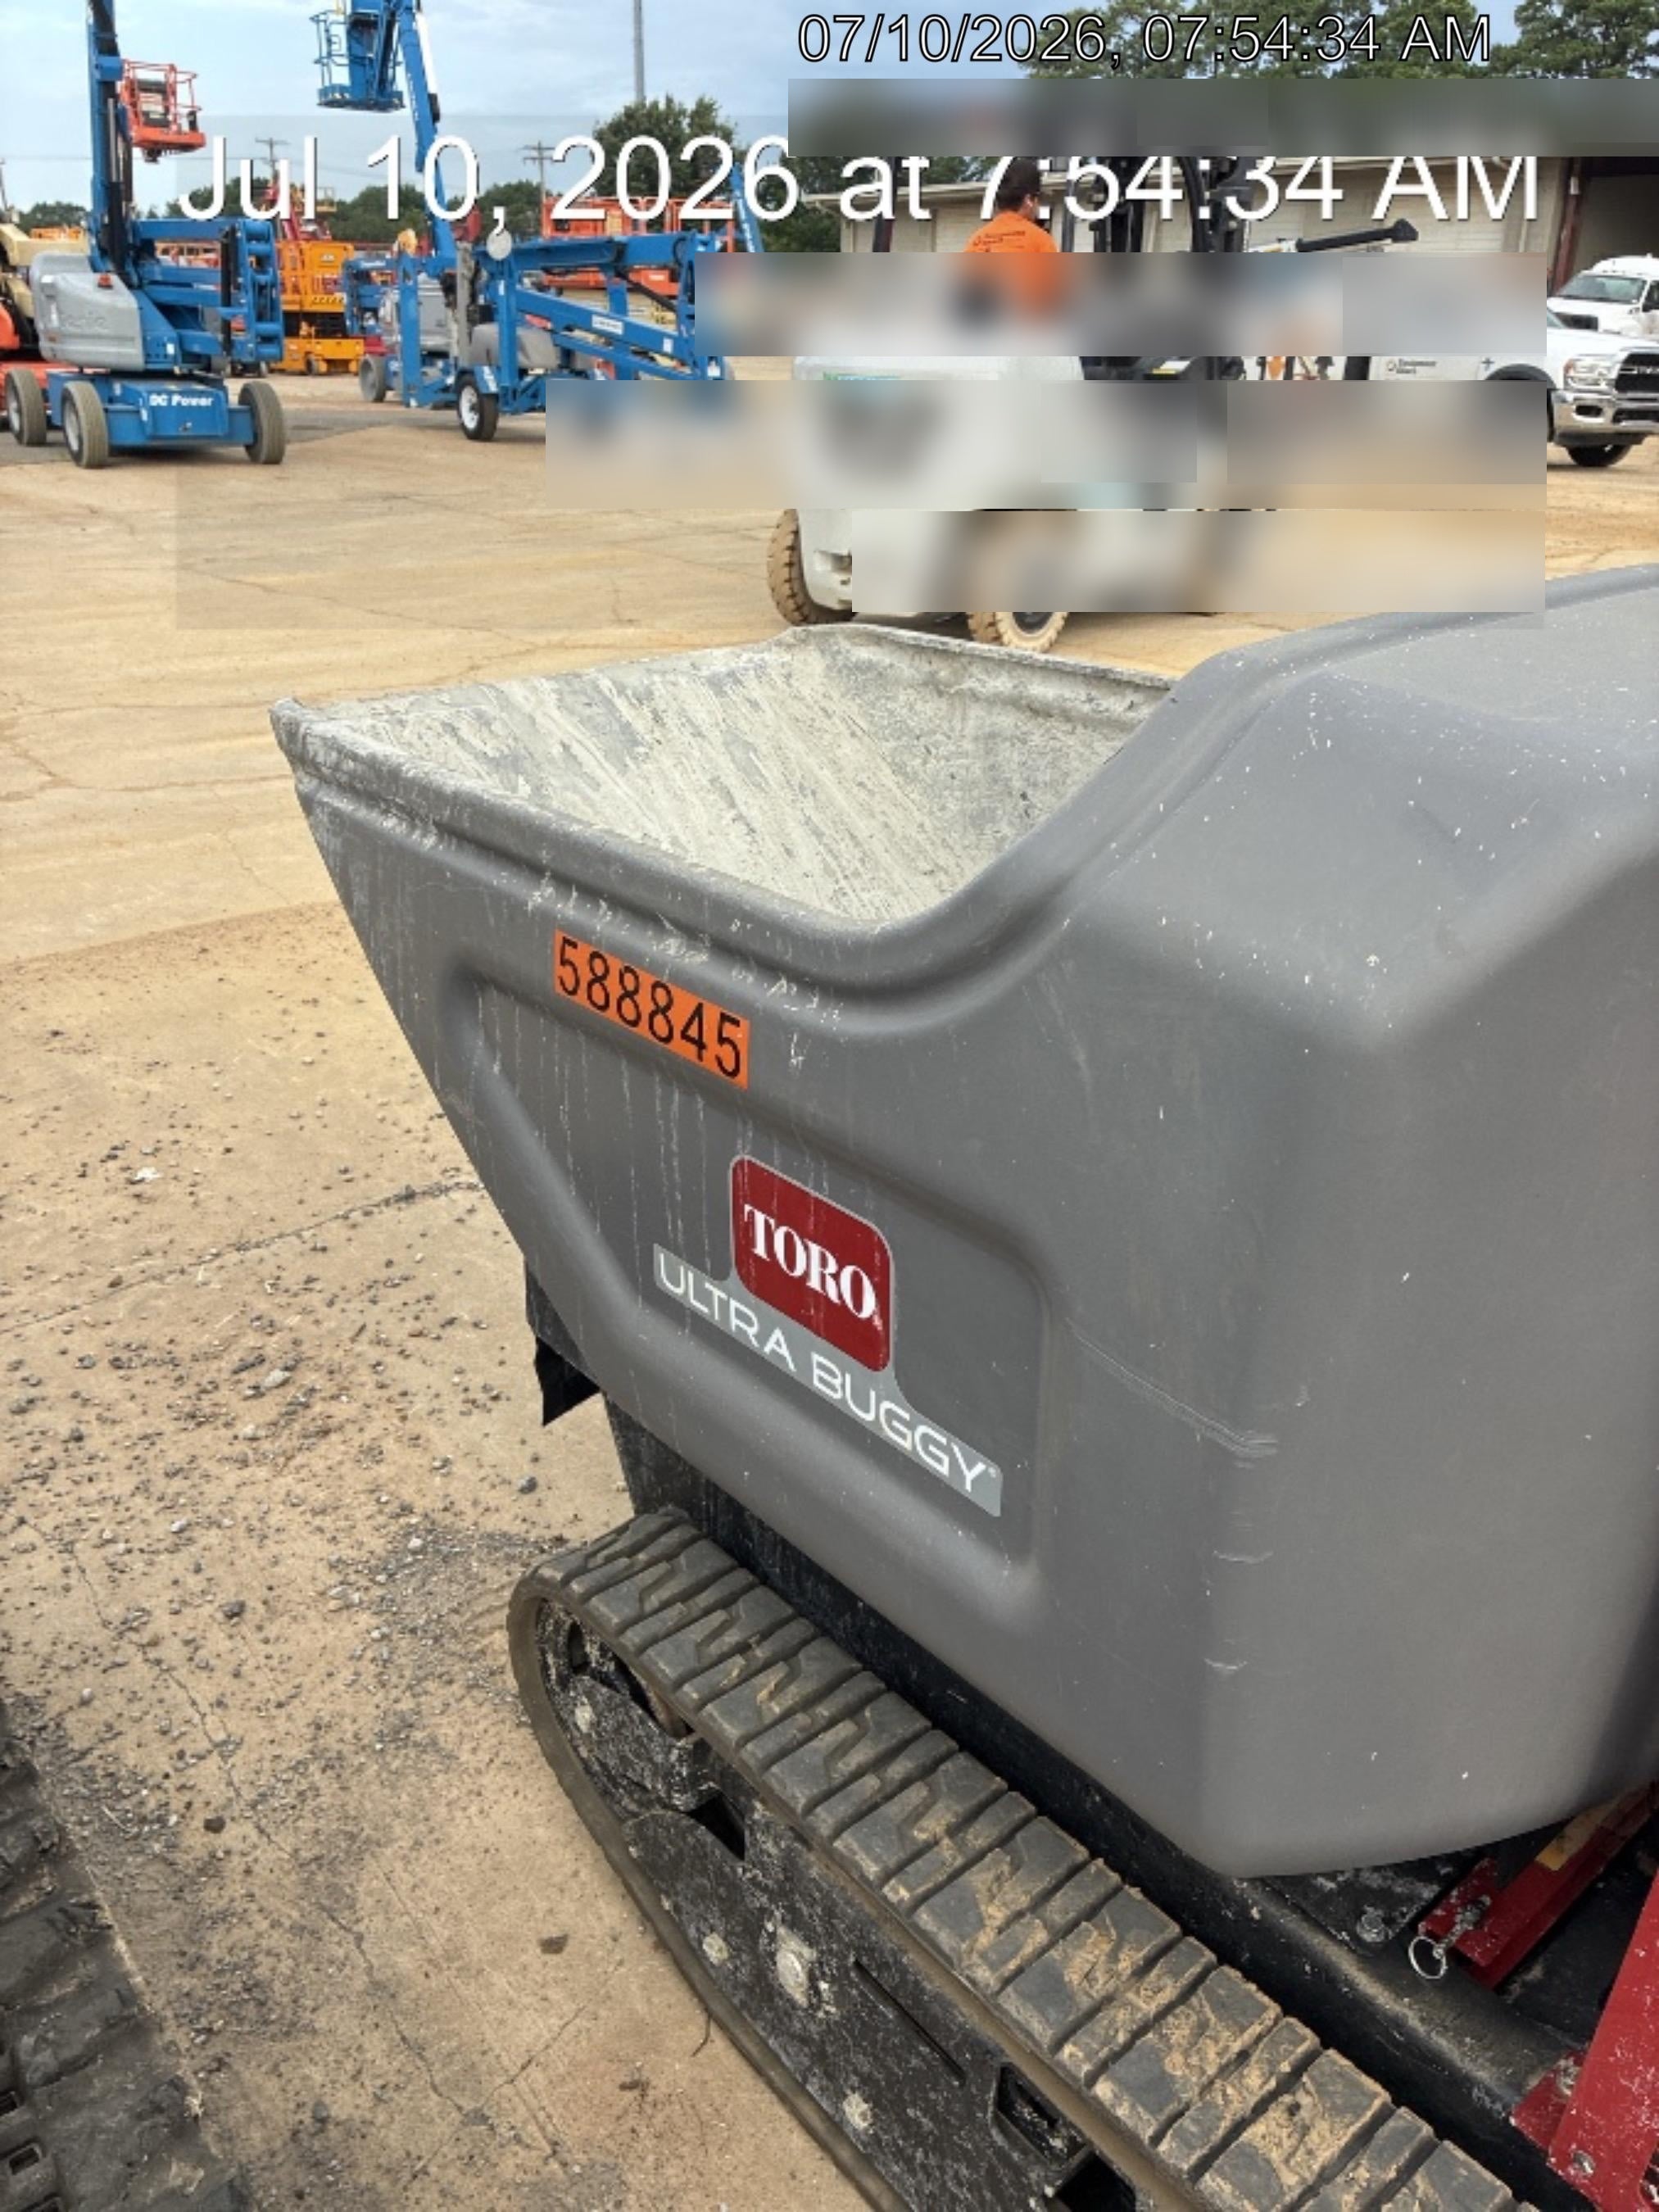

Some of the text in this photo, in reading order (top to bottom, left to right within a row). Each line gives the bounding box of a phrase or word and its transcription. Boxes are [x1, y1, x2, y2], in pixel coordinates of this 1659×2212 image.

[171, 394, 213, 406] Power
[558, 936, 741, 1079] 588845
[744, 1203, 877, 1321] TORO
[659, 1253, 986, 1493] ULTRA BUGGY
